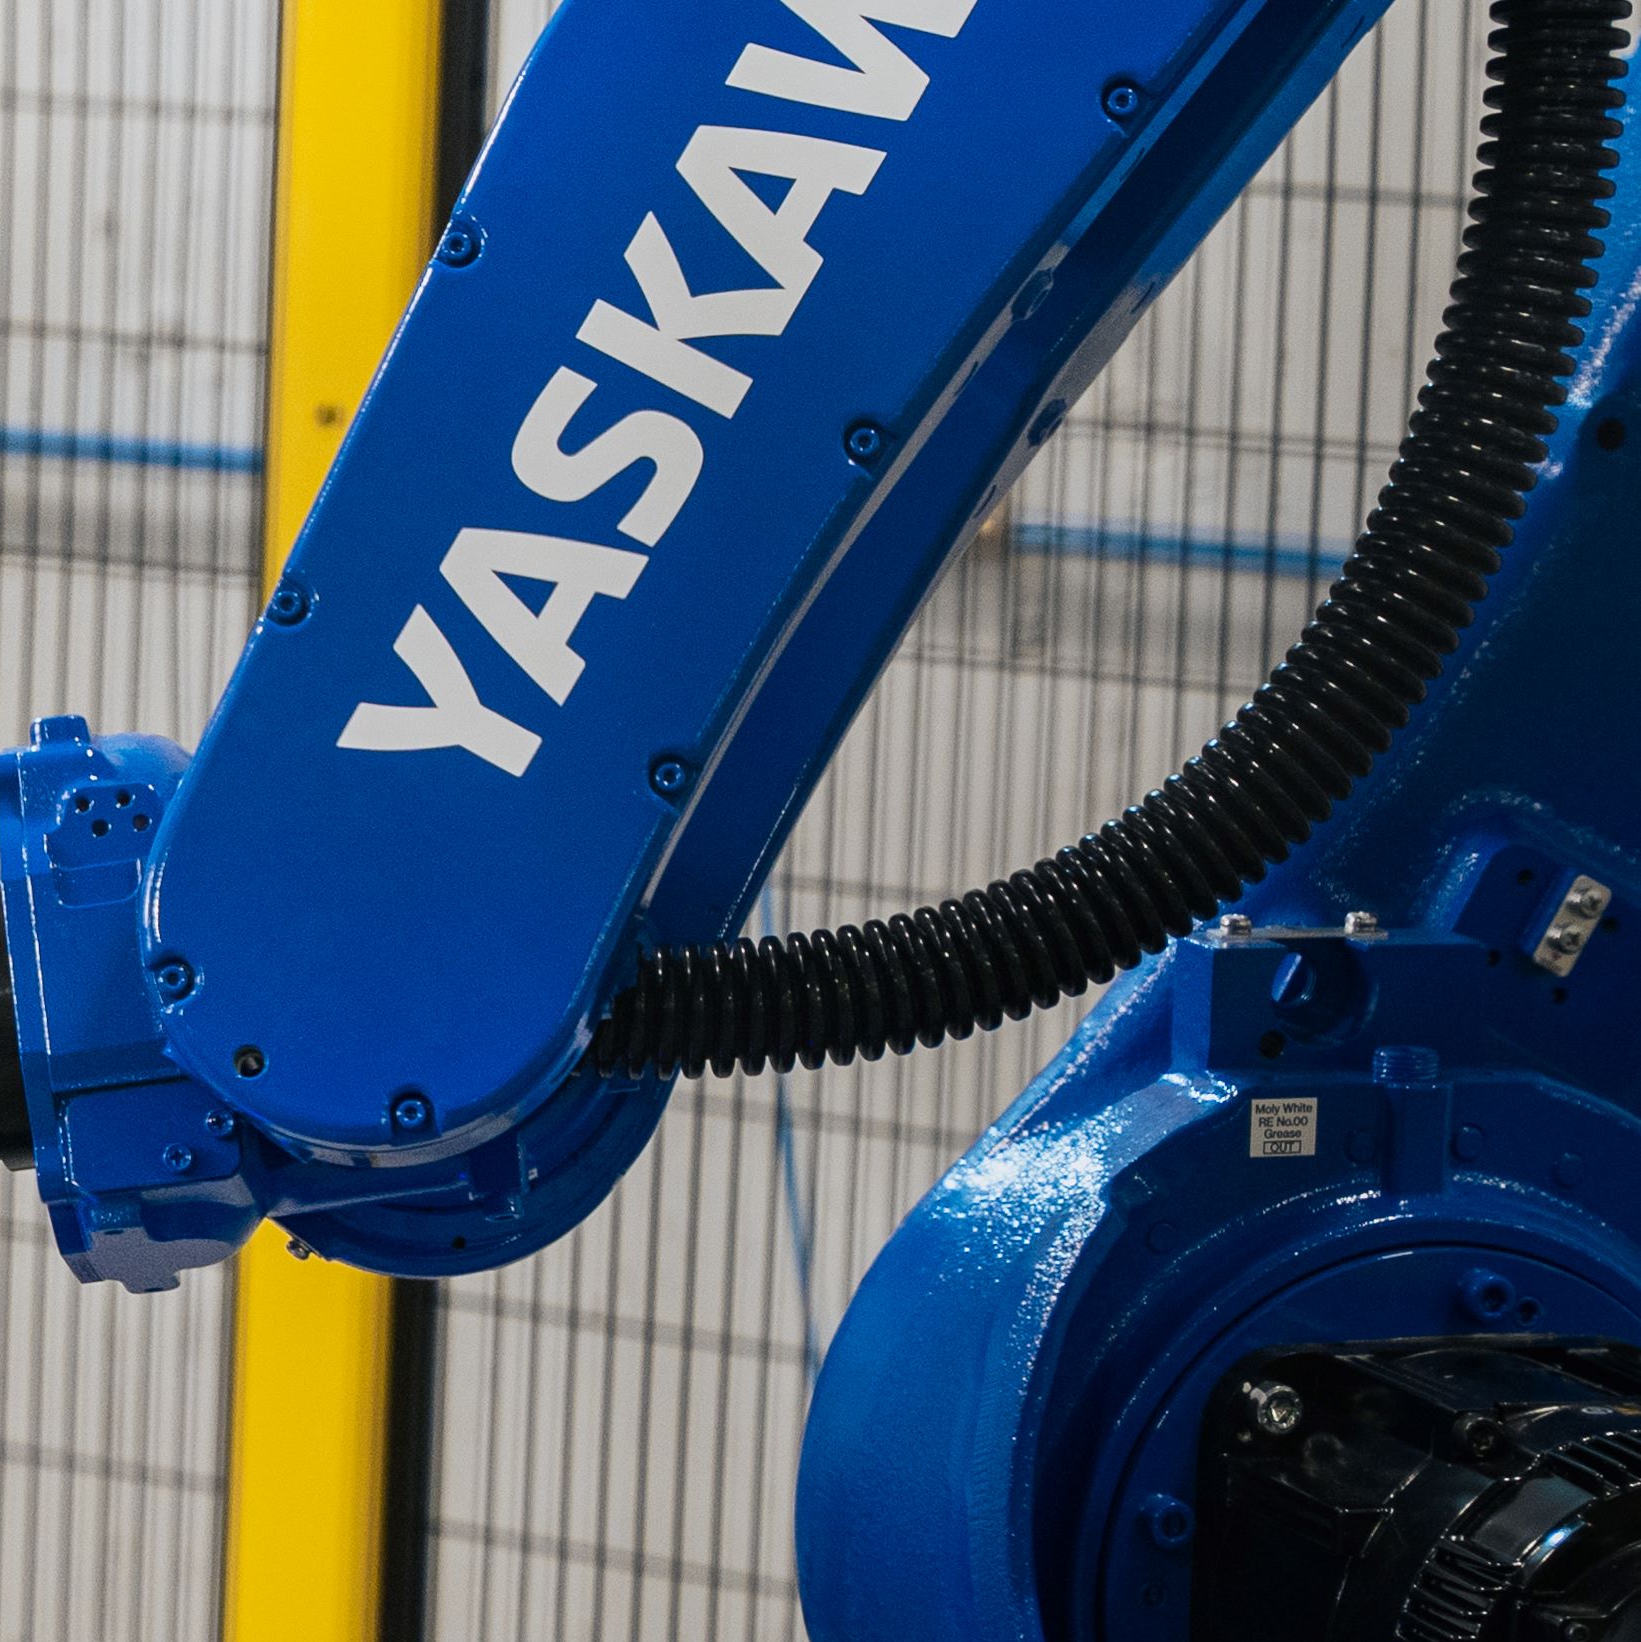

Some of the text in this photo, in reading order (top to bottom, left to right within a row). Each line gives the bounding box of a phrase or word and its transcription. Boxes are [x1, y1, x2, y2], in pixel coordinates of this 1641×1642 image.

[1255, 1103, 1313, 1116] Moly White
[1258, 1116, 1274, 1128] RE
[1264, 1128, 1302, 1140] Grease
[1269, 1140, 1296, 1153] OUT
